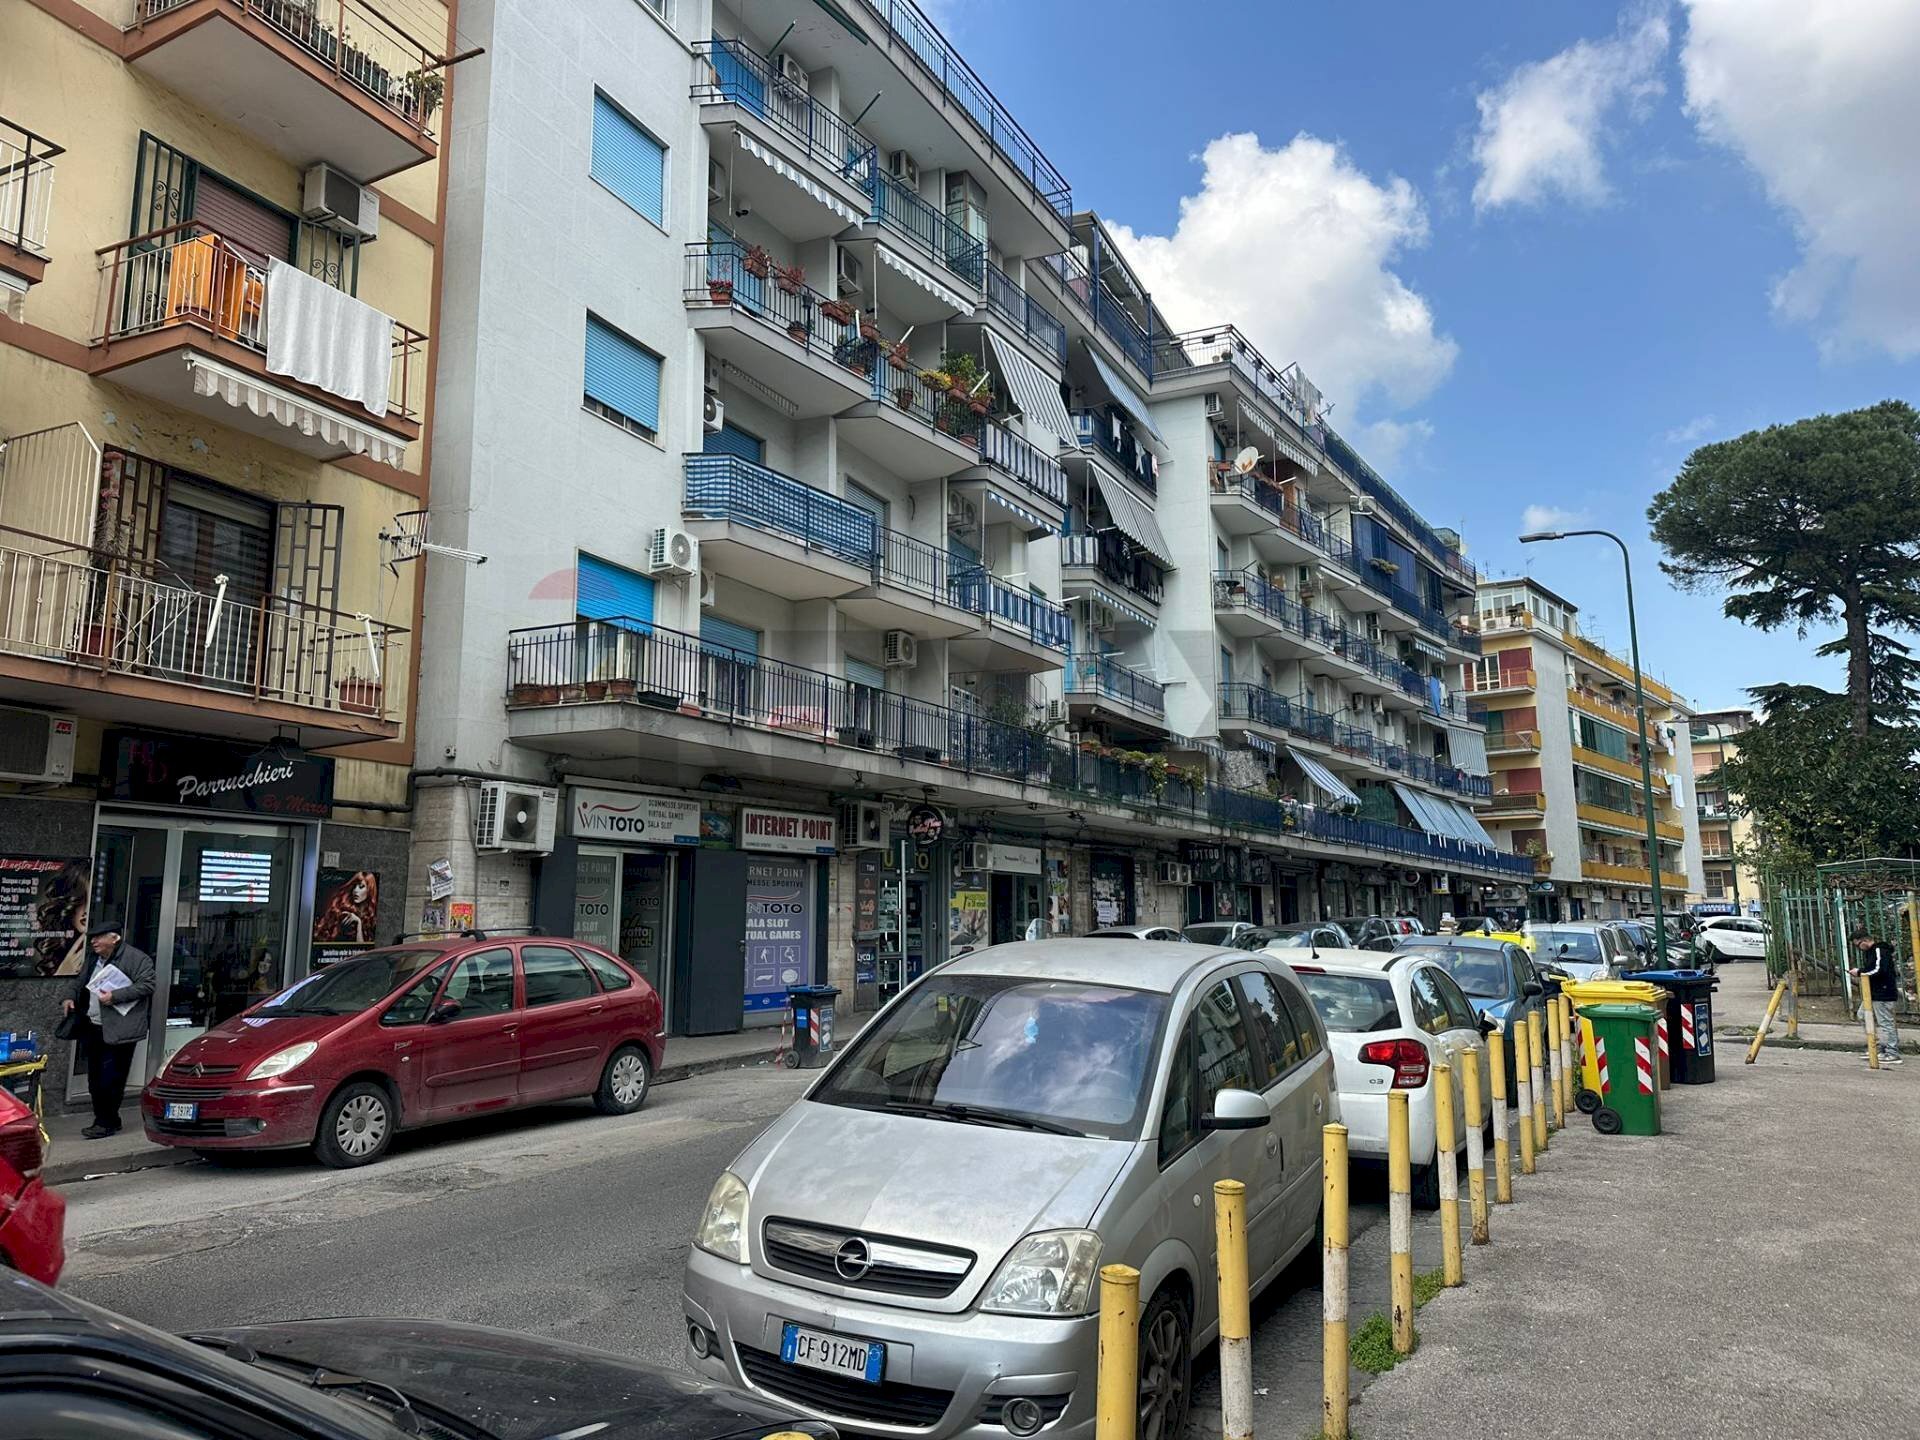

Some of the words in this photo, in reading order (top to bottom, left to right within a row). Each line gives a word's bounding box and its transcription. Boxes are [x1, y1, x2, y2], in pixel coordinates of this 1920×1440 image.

[177, 761, 294, 804] Parrucchieri
[745, 813, 799, 838] INTERNET
[802, 818, 832, 841] POINT
[1189, 849, 1220, 861] TATTOO
[777, 868, 804, 878] POINT
[766, 918, 790, 928] SLOT
[769, 931, 801, 940] GAMES
[856, 953, 870, 963] Lyca
